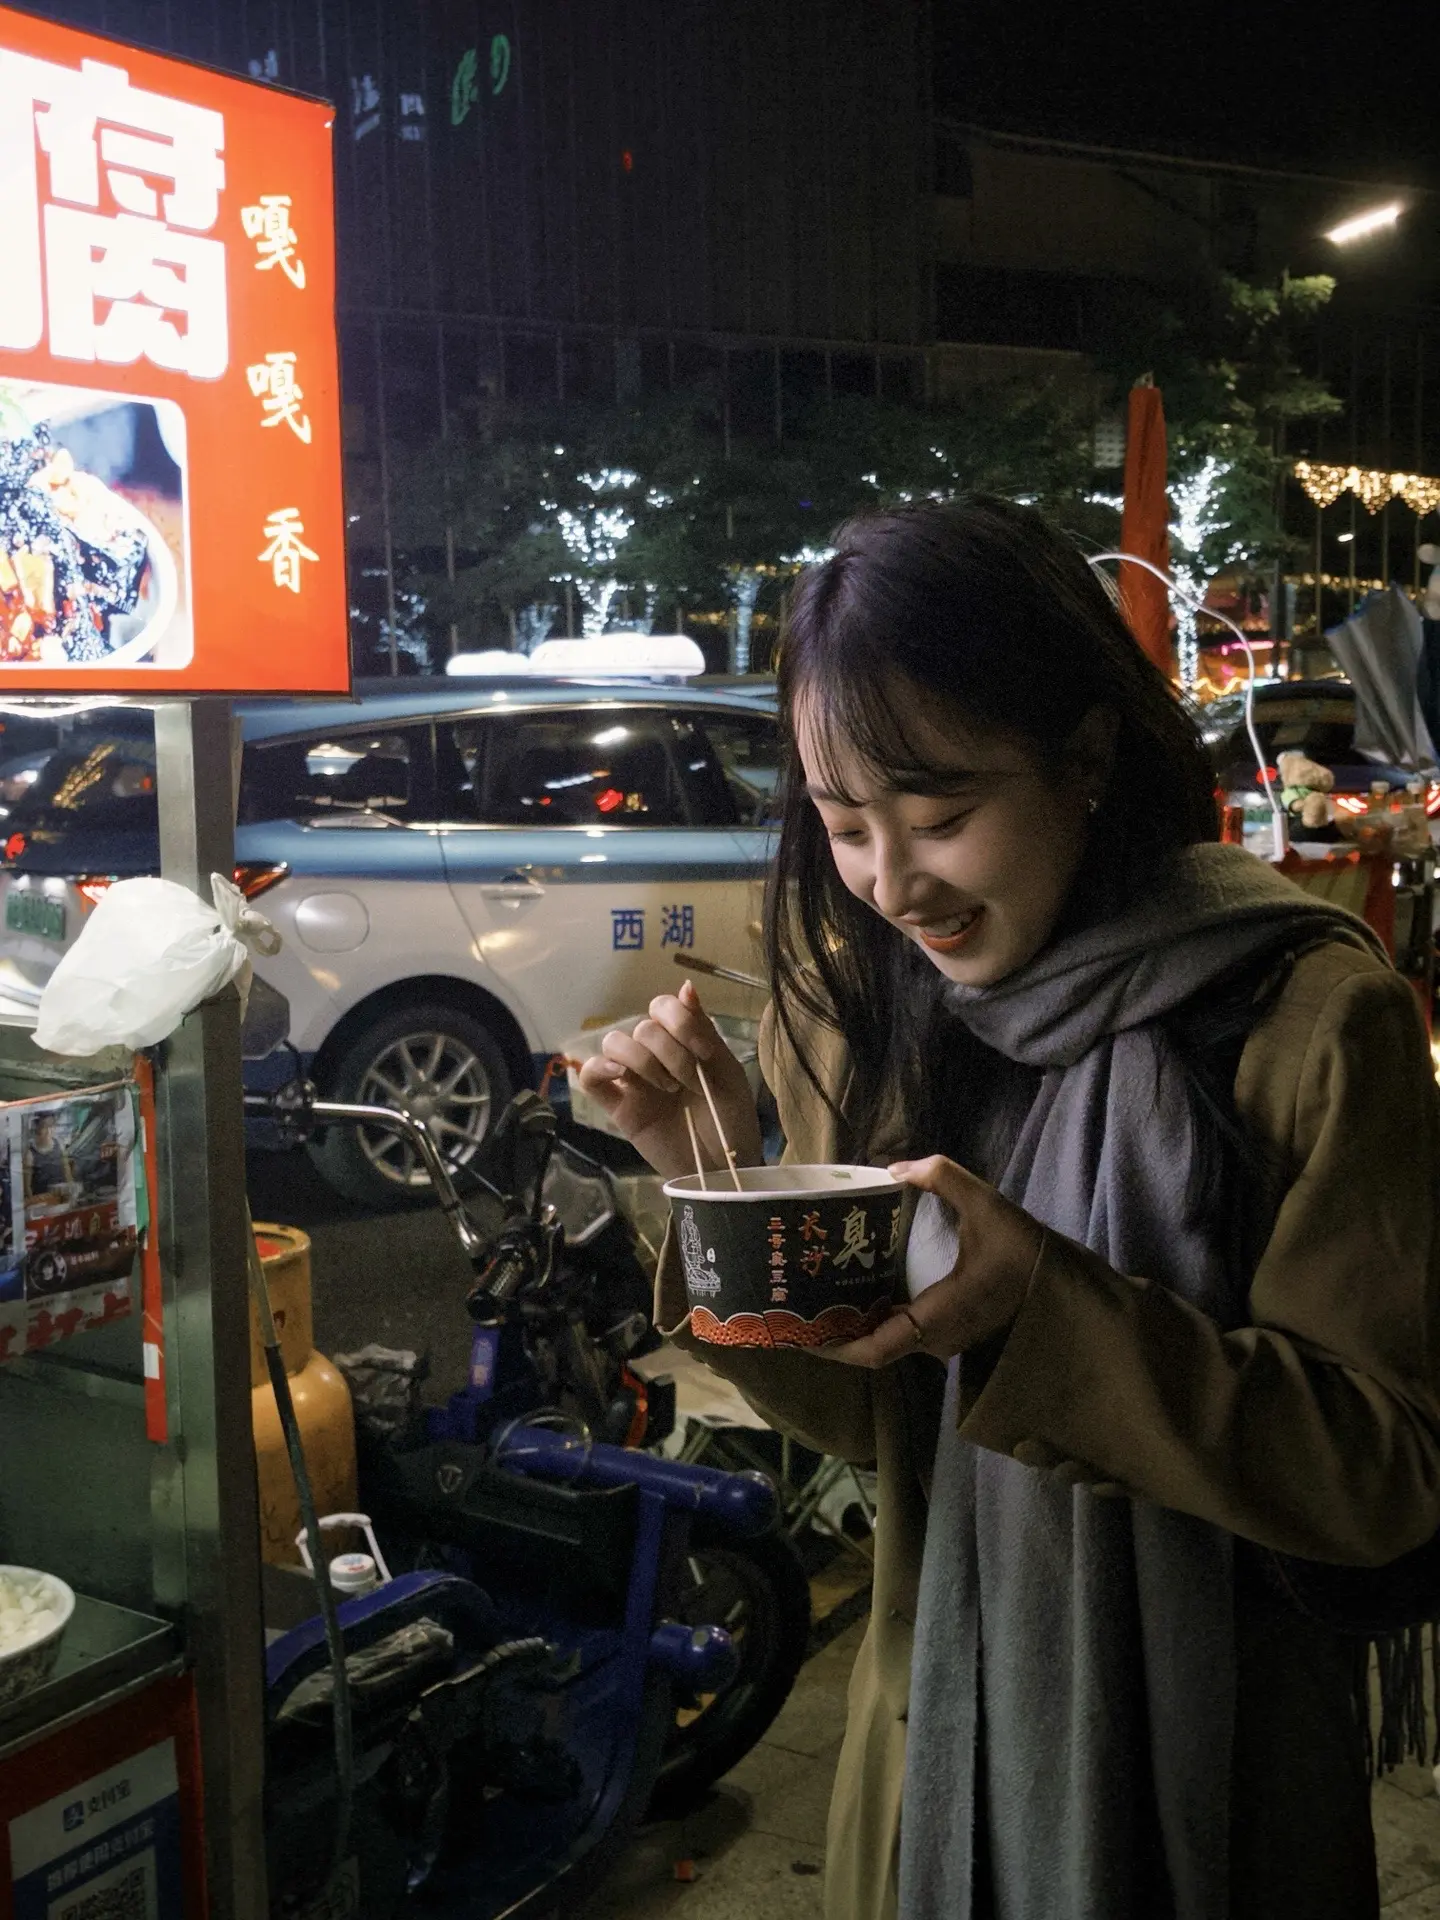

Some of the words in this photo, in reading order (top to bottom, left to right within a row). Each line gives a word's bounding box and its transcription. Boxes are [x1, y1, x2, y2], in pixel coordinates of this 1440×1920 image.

[240, 195, 320, 593] 嘎嘎香
[611, 904, 694, 950] 西湖
